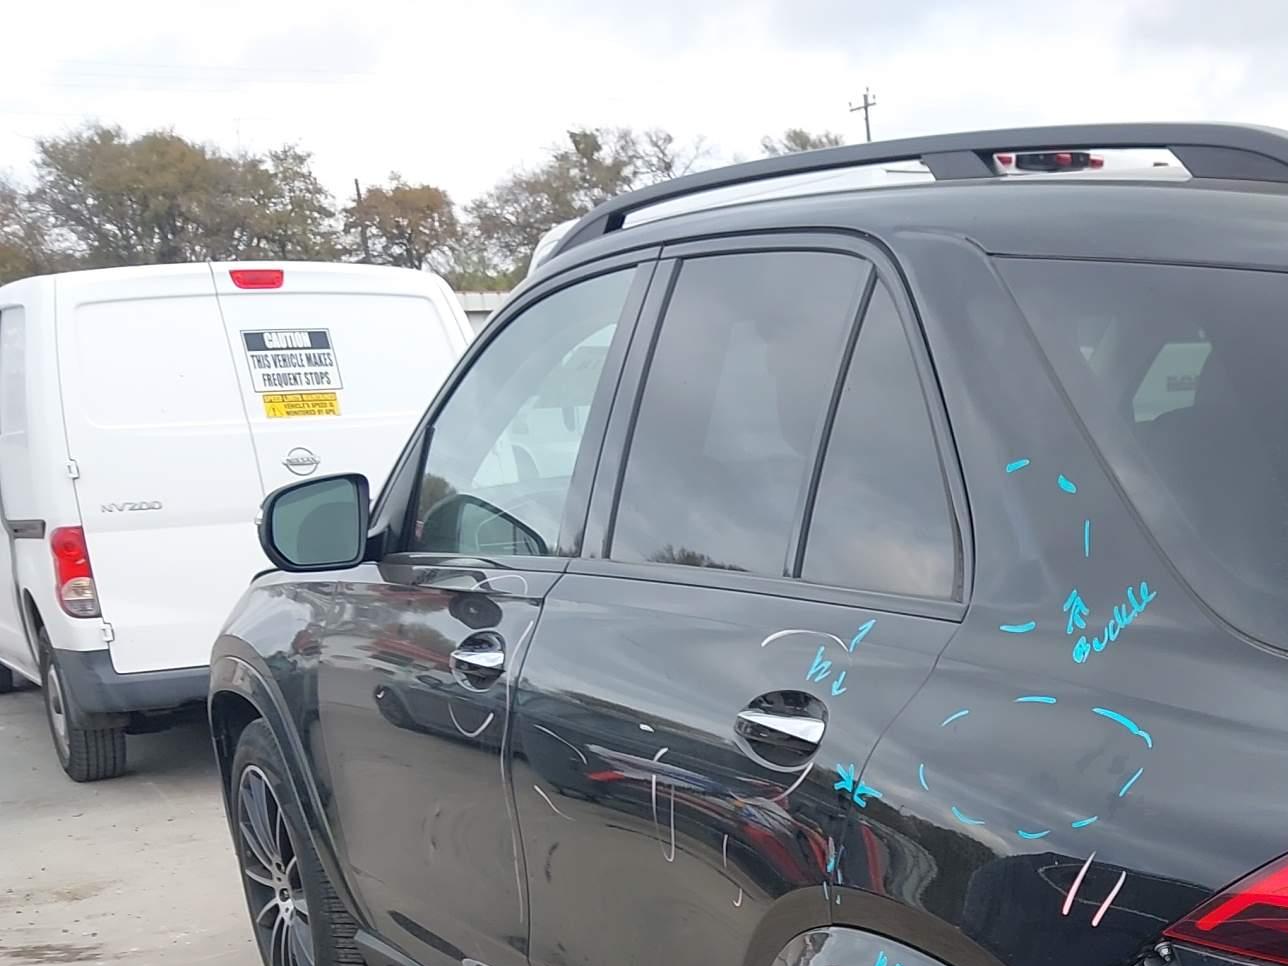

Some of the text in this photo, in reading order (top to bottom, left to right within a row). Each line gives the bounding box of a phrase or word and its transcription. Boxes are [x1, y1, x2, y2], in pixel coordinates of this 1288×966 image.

[263, 332, 312, 349] CAUTION
[250, 352, 333, 369] THIS VEHICLE MAKES
[262, 371, 331, 388] FREQUENT STOPS
[101, 501, 162, 512] NV200
